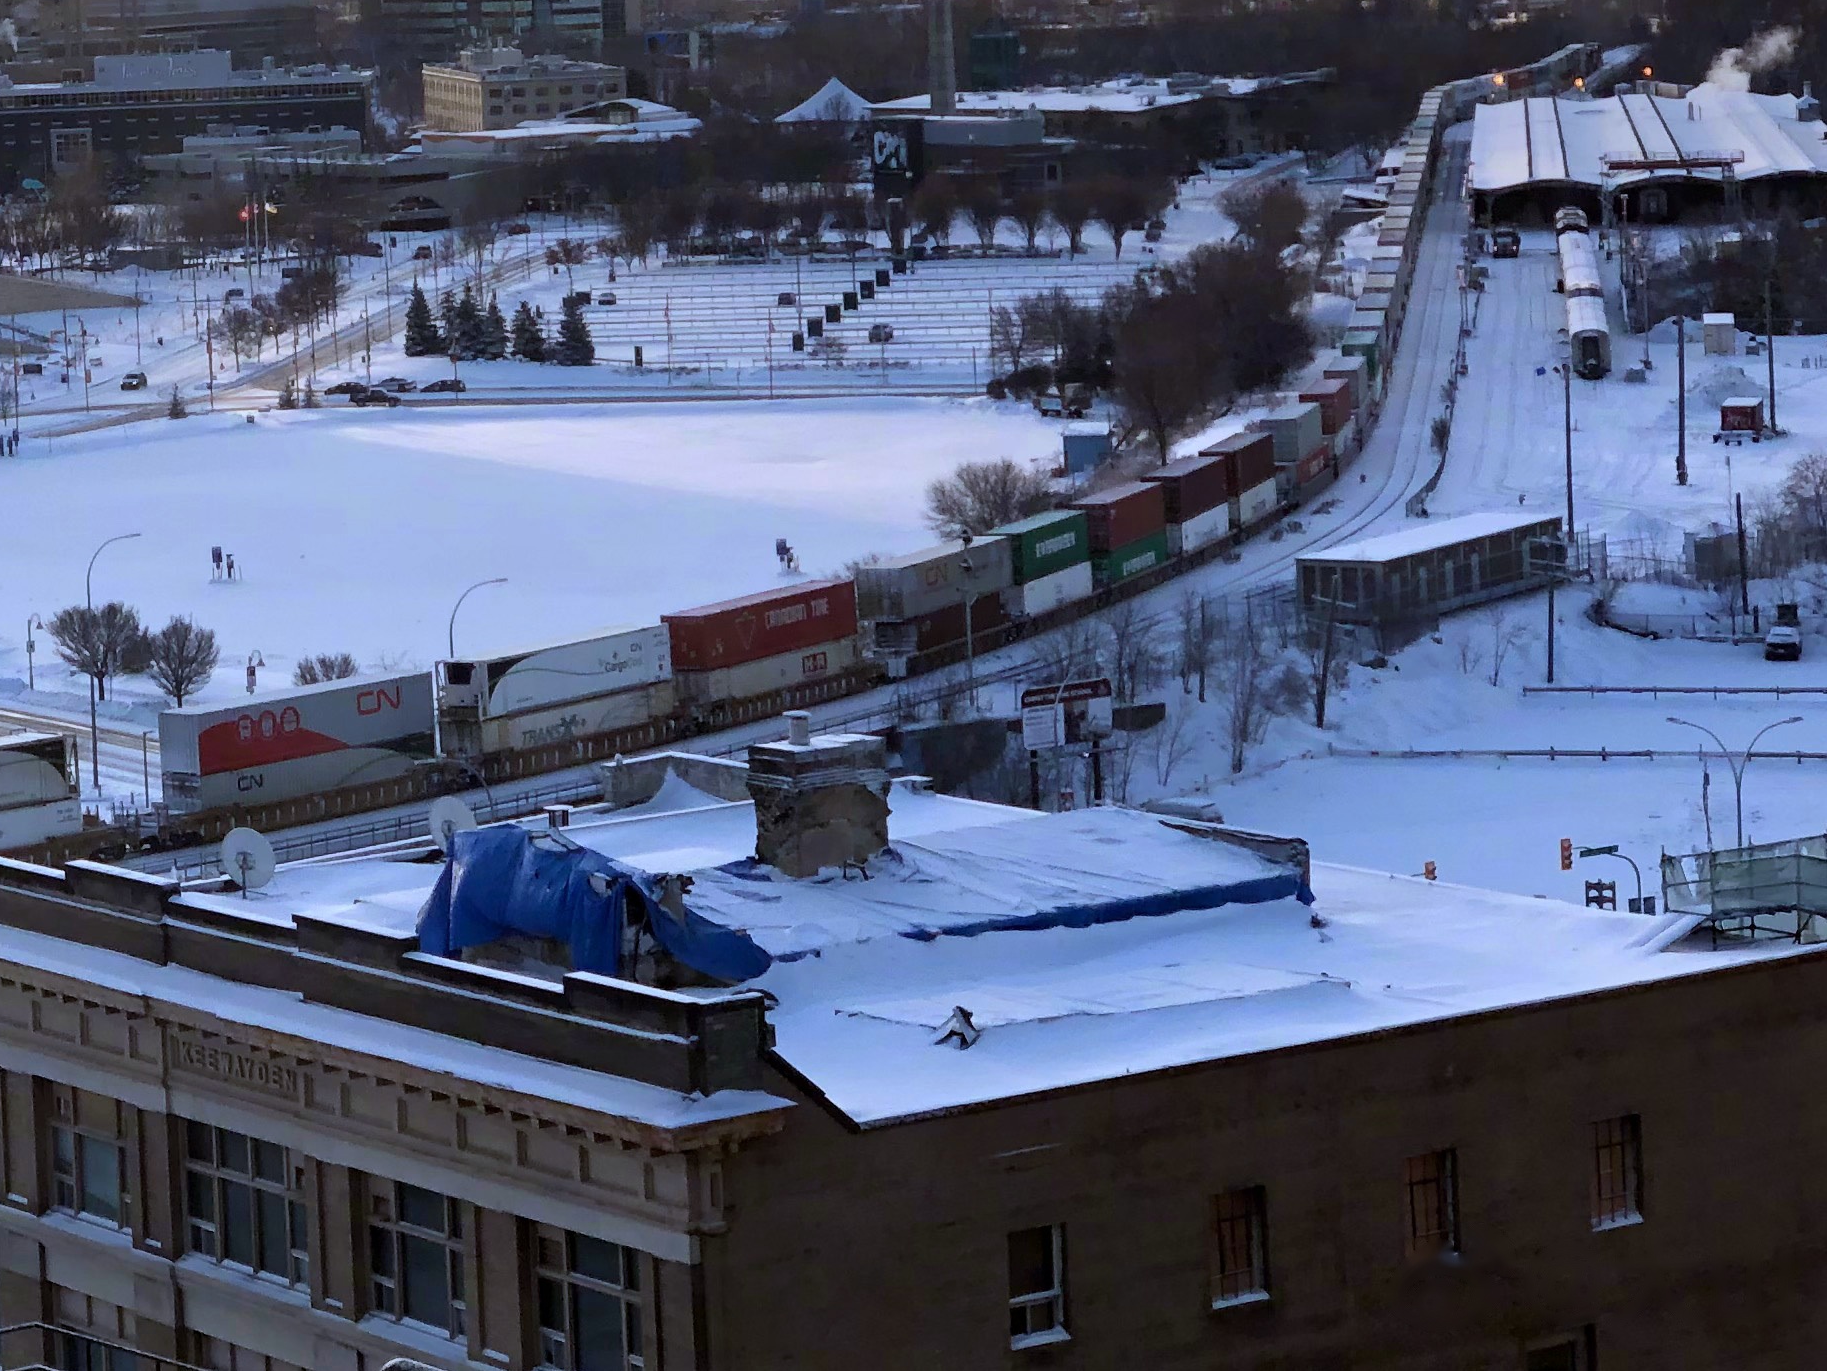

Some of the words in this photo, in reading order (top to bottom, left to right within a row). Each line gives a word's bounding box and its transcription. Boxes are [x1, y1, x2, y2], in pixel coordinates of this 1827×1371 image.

[356, 686, 401, 716] CN
[237, 773, 264, 792] CN
[180, 1040, 297, 1093] KEEWAYDEN
